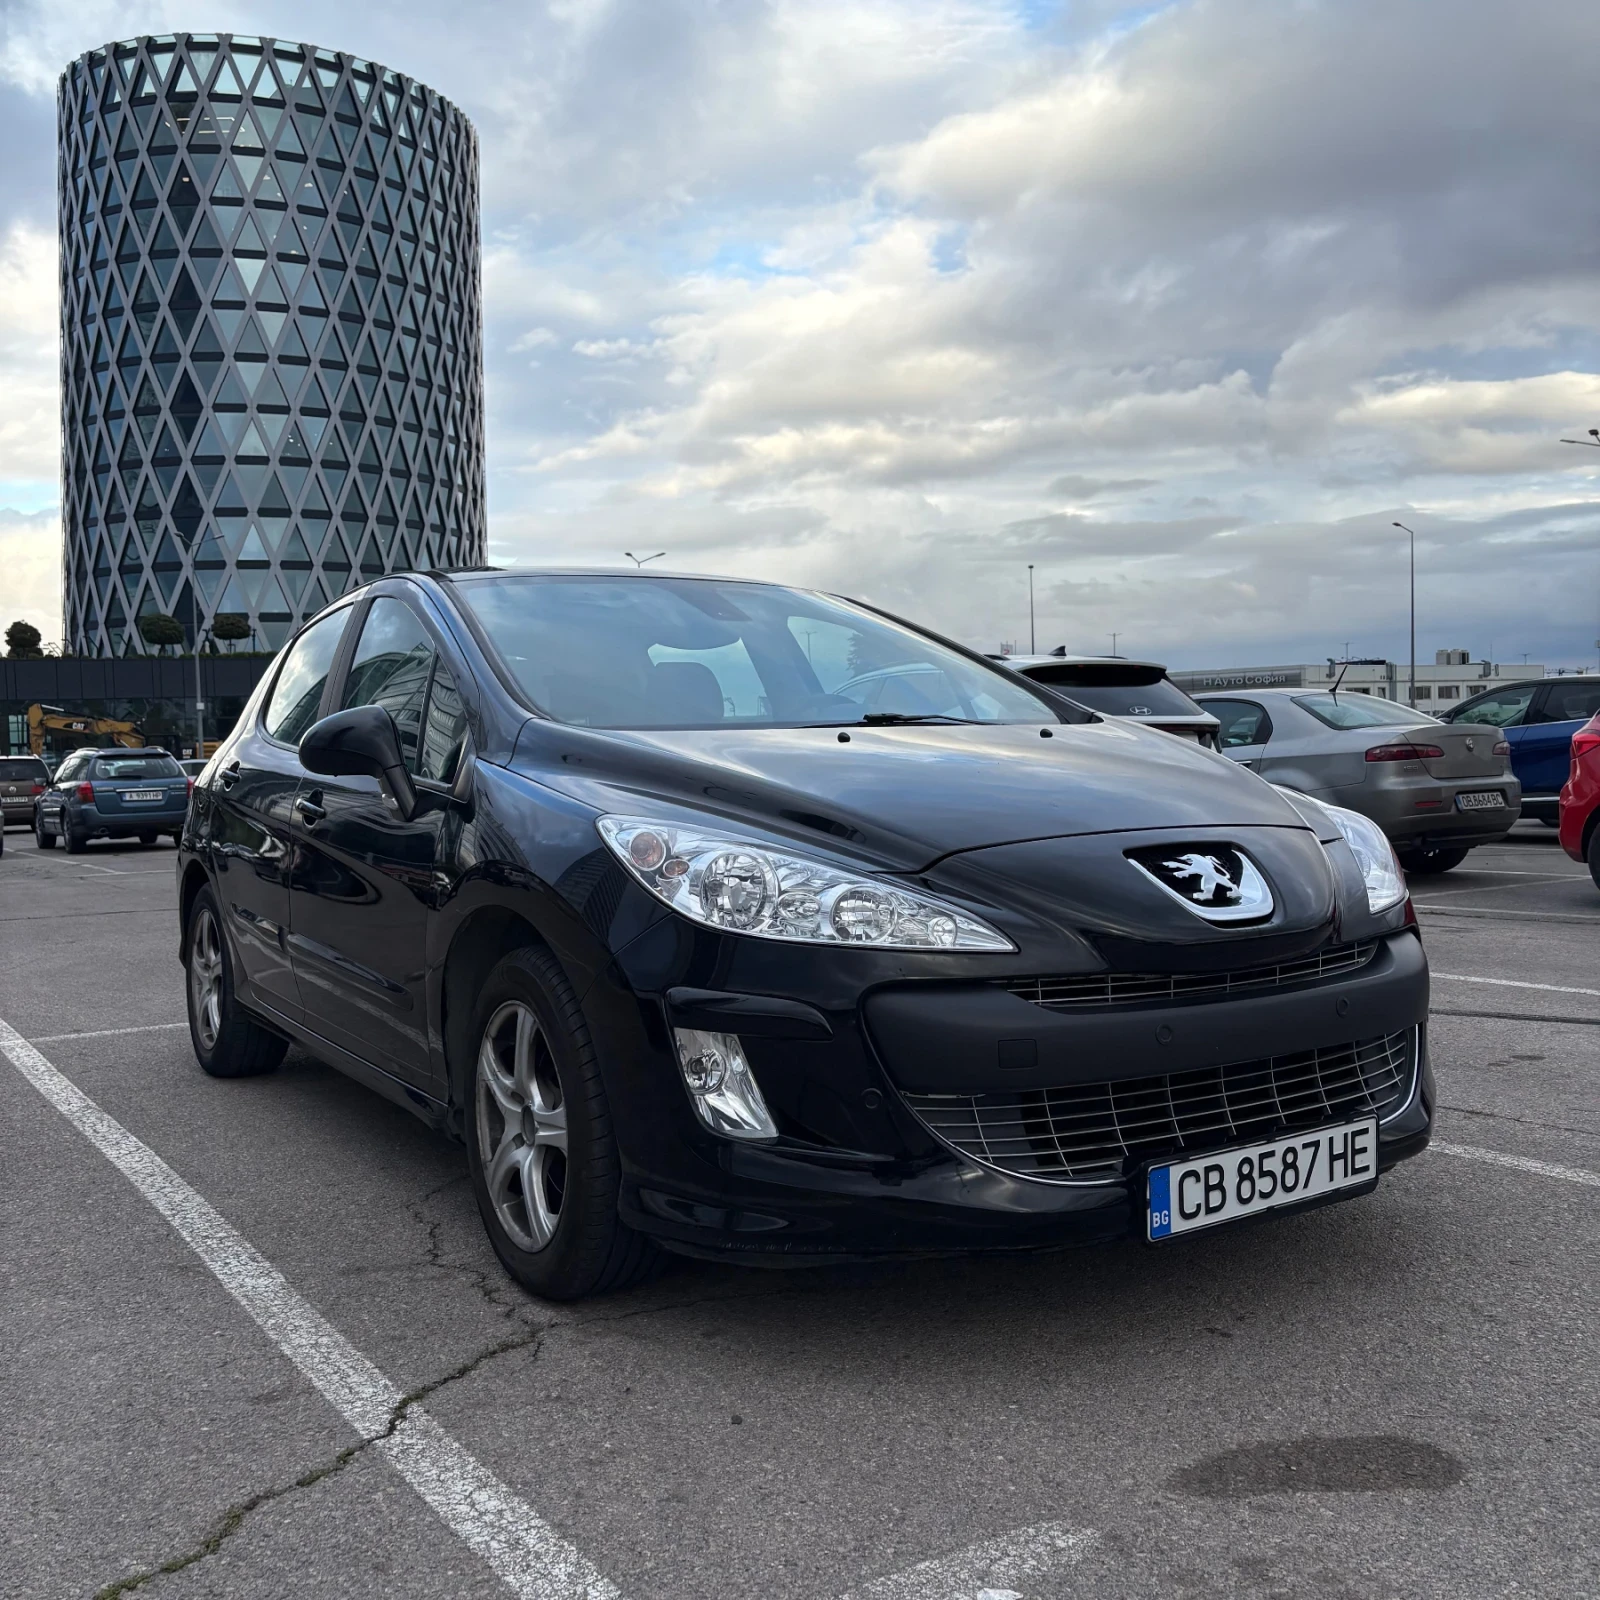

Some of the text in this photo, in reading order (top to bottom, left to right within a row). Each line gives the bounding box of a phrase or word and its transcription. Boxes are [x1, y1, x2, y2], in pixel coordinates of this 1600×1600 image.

[72, 721, 85, 731] CAT
[1178, 1126, 1371, 1221] CB 8587 HE
[1152, 1210, 1169, 1228] BG
